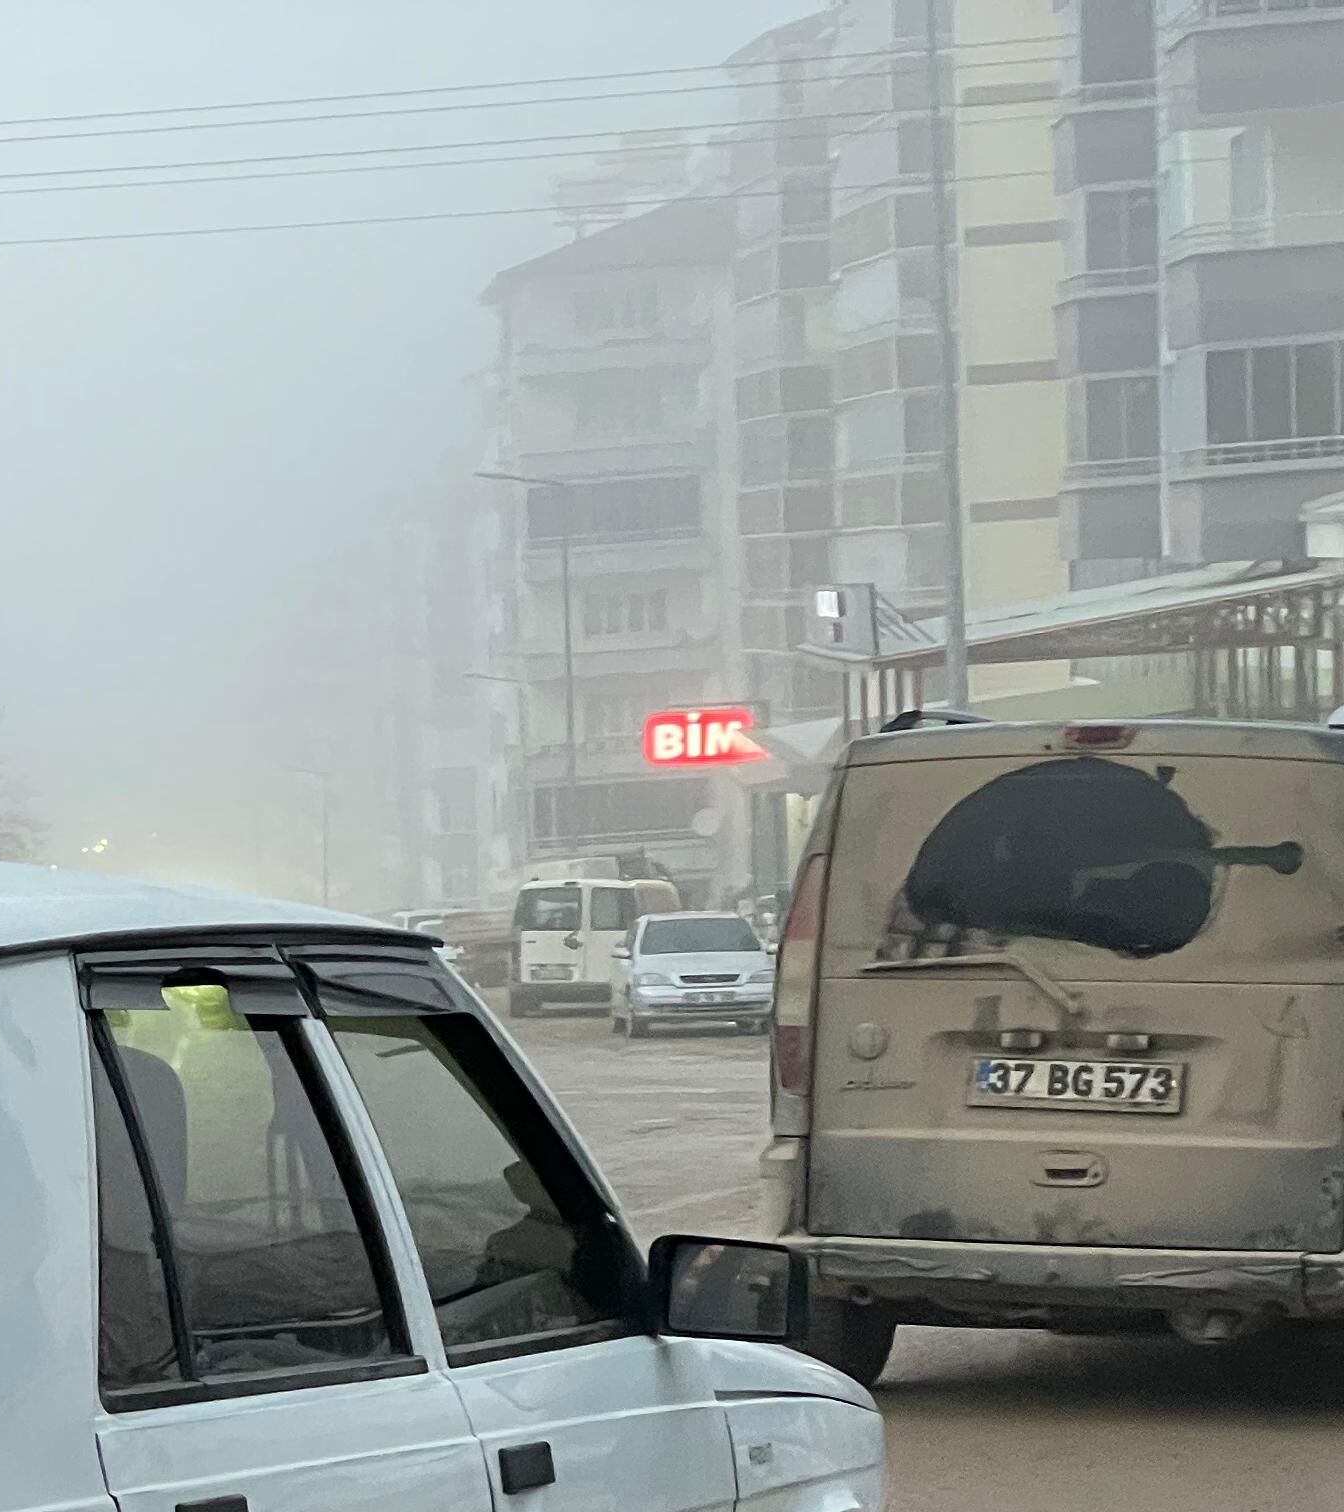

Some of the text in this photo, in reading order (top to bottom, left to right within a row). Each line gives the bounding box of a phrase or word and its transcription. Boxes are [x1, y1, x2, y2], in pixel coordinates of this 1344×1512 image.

[988, 1062, 1173, 1100] 37 BG 573
